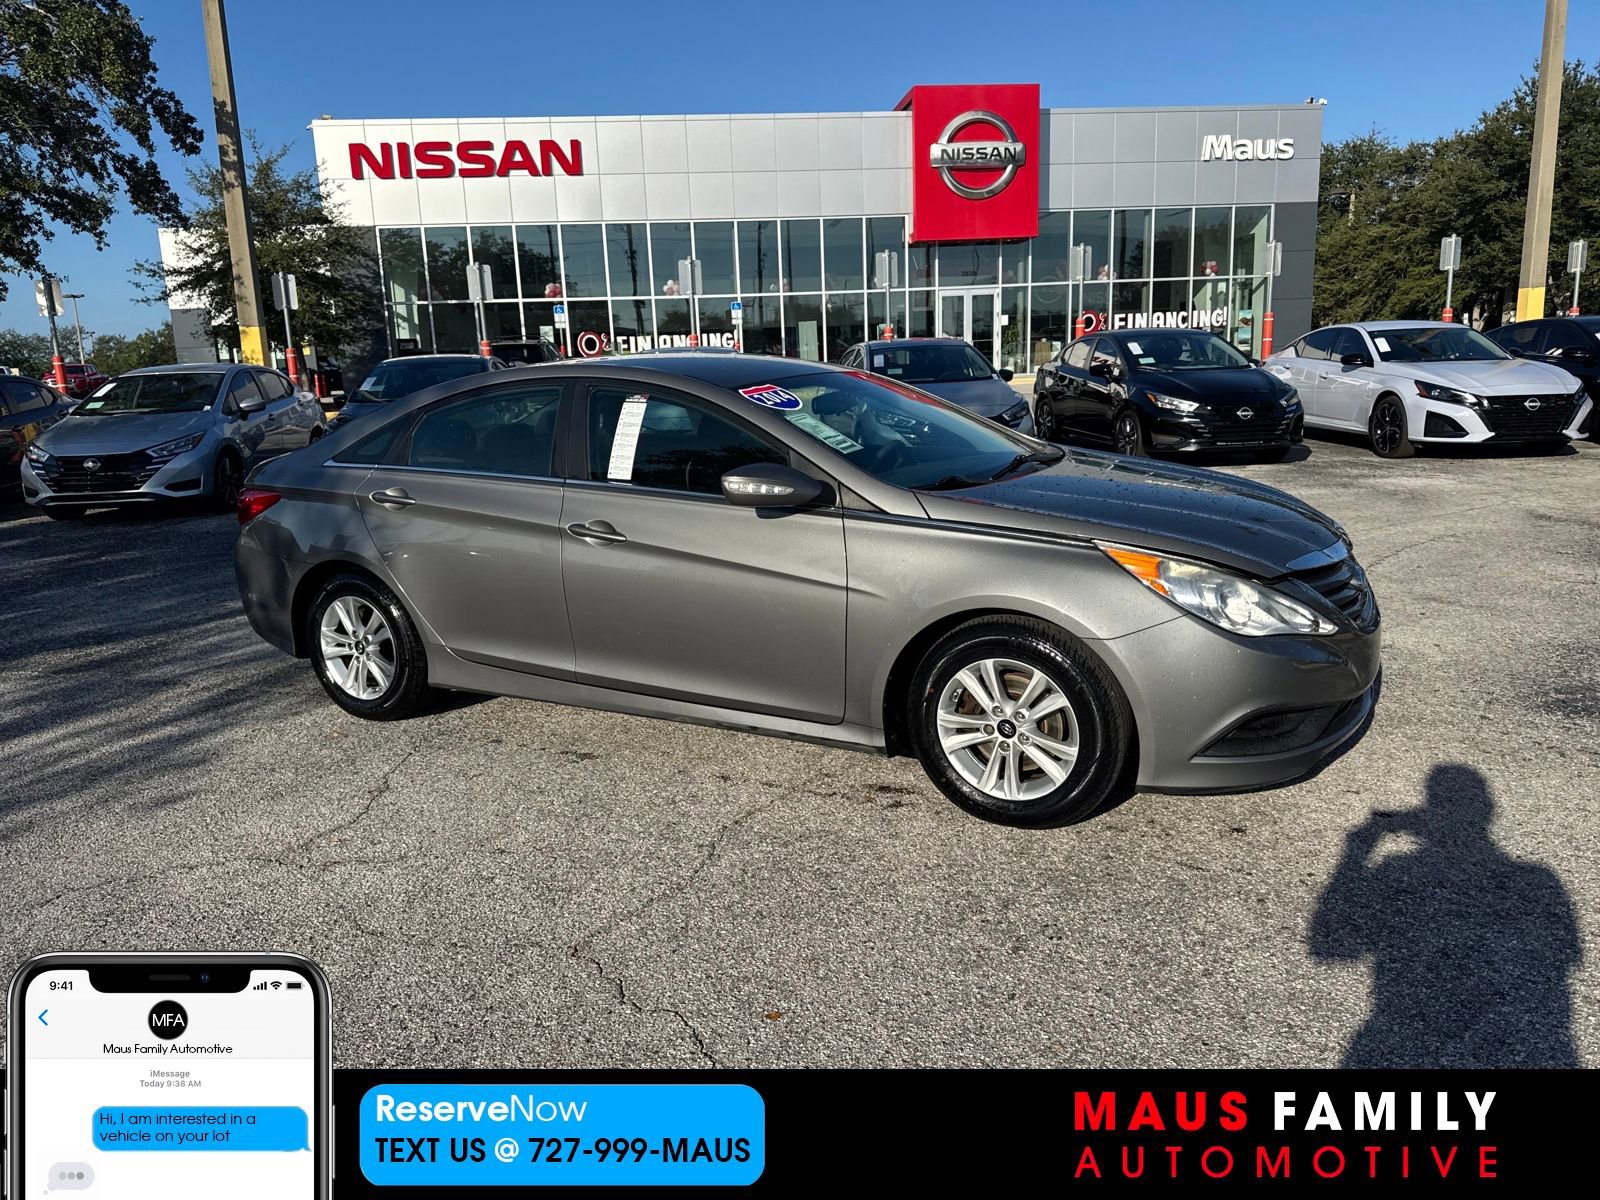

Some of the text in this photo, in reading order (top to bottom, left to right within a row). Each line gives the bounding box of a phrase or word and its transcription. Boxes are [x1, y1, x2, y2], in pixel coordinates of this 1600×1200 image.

[348, 139, 583, 180] NISSAN
[940, 147, 1017, 161] NISSAN
[1201, 134, 1295, 162] Maus
[1113, 307, 1228, 330] FINANCING!
